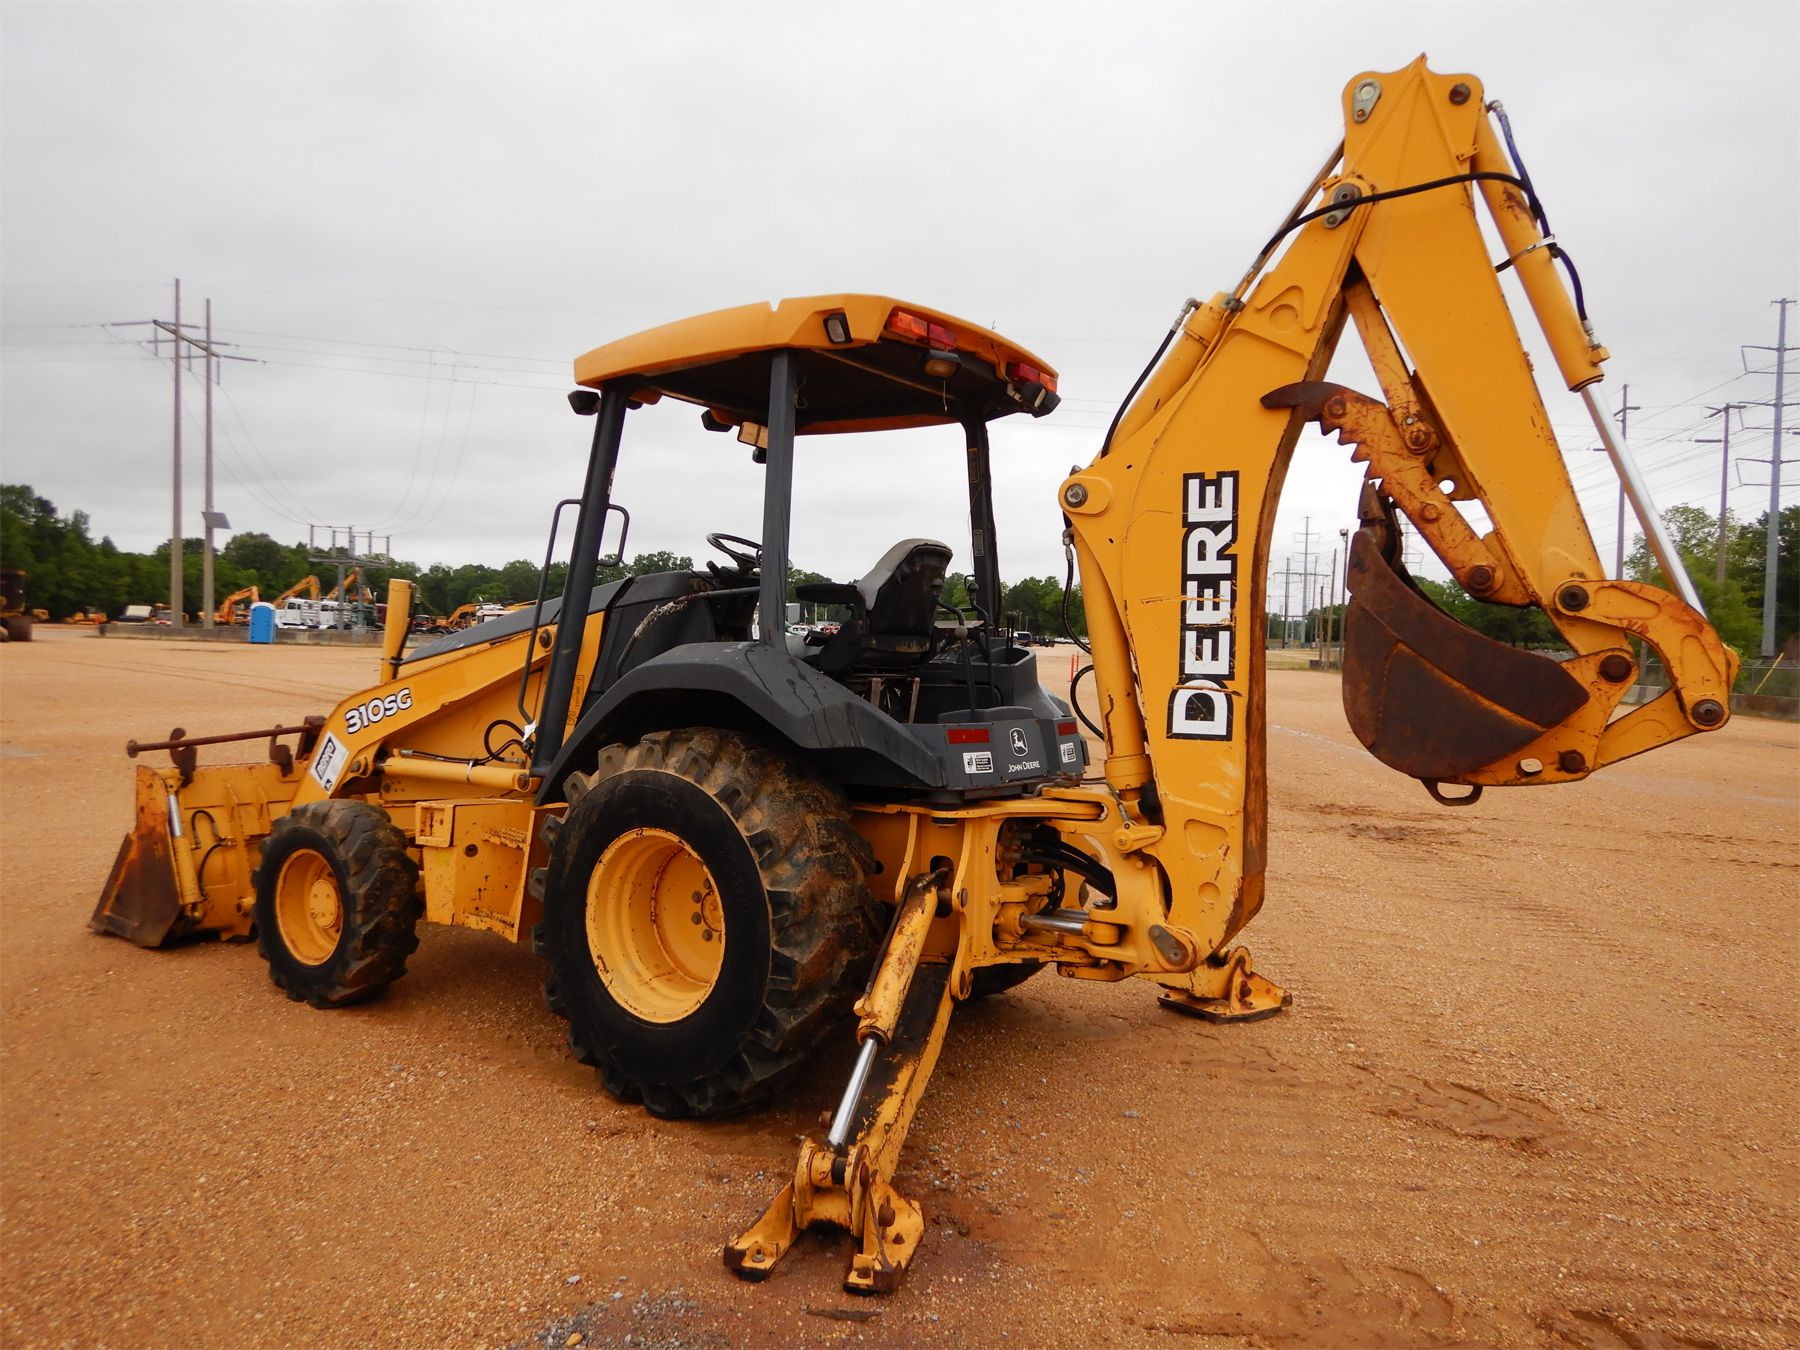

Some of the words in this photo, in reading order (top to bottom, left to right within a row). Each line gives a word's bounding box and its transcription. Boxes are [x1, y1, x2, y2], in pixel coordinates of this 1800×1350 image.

[1168, 471, 1237, 738] DEERE
[345, 688, 412, 734] 310SG
[1008, 763, 1023, 773] JOHN
[1022, 761, 1040, 770] DEERE
